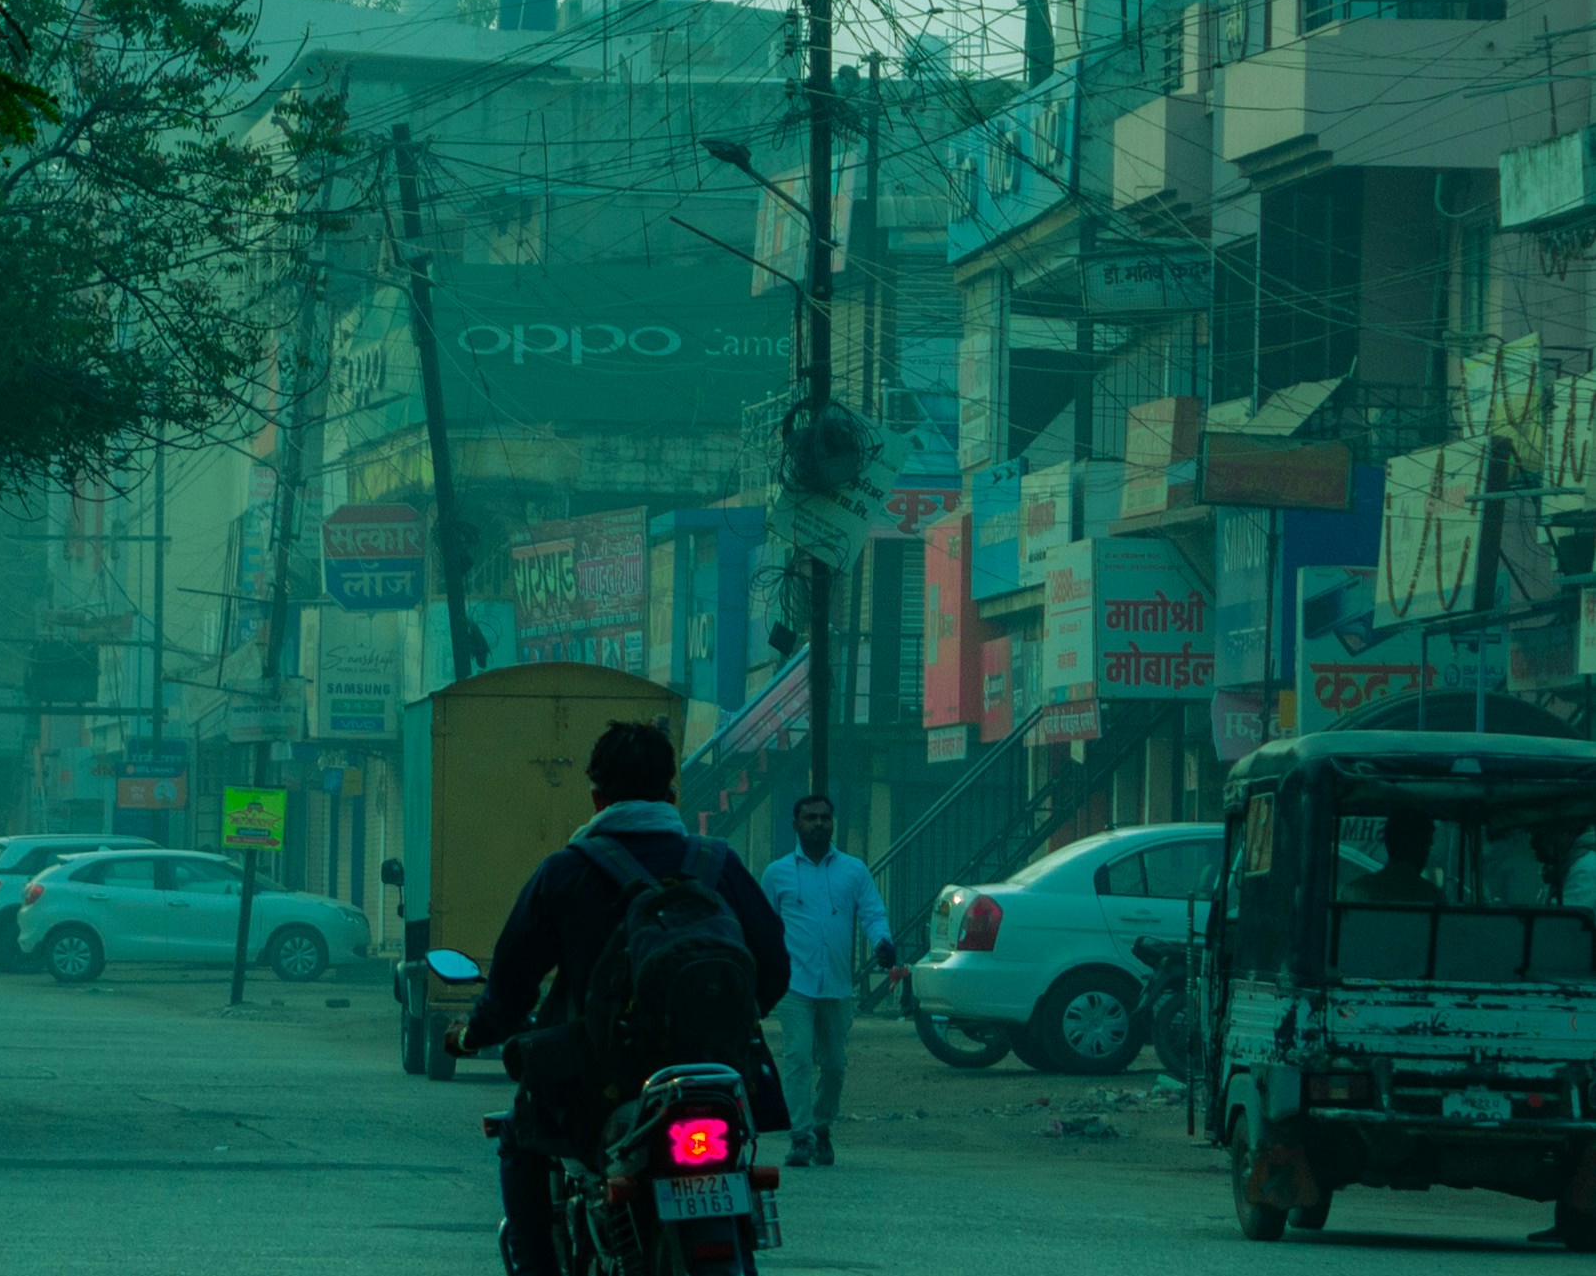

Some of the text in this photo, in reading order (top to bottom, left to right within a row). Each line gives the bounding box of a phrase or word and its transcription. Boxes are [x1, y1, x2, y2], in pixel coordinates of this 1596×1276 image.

[457, 324, 683, 365] oppo
[329, 523, 424, 556] सत्कार
[340, 562, 417, 598] लॉज
[1104, 589, 1208, 633] मातोश्री
[1104, 640, 1215, 691] मोबाईल
[327, 683, 391, 695] SAMSUNG
[670, 1174, 731, 1197] MH22A
[674, 1194, 735, 1217] T8163
